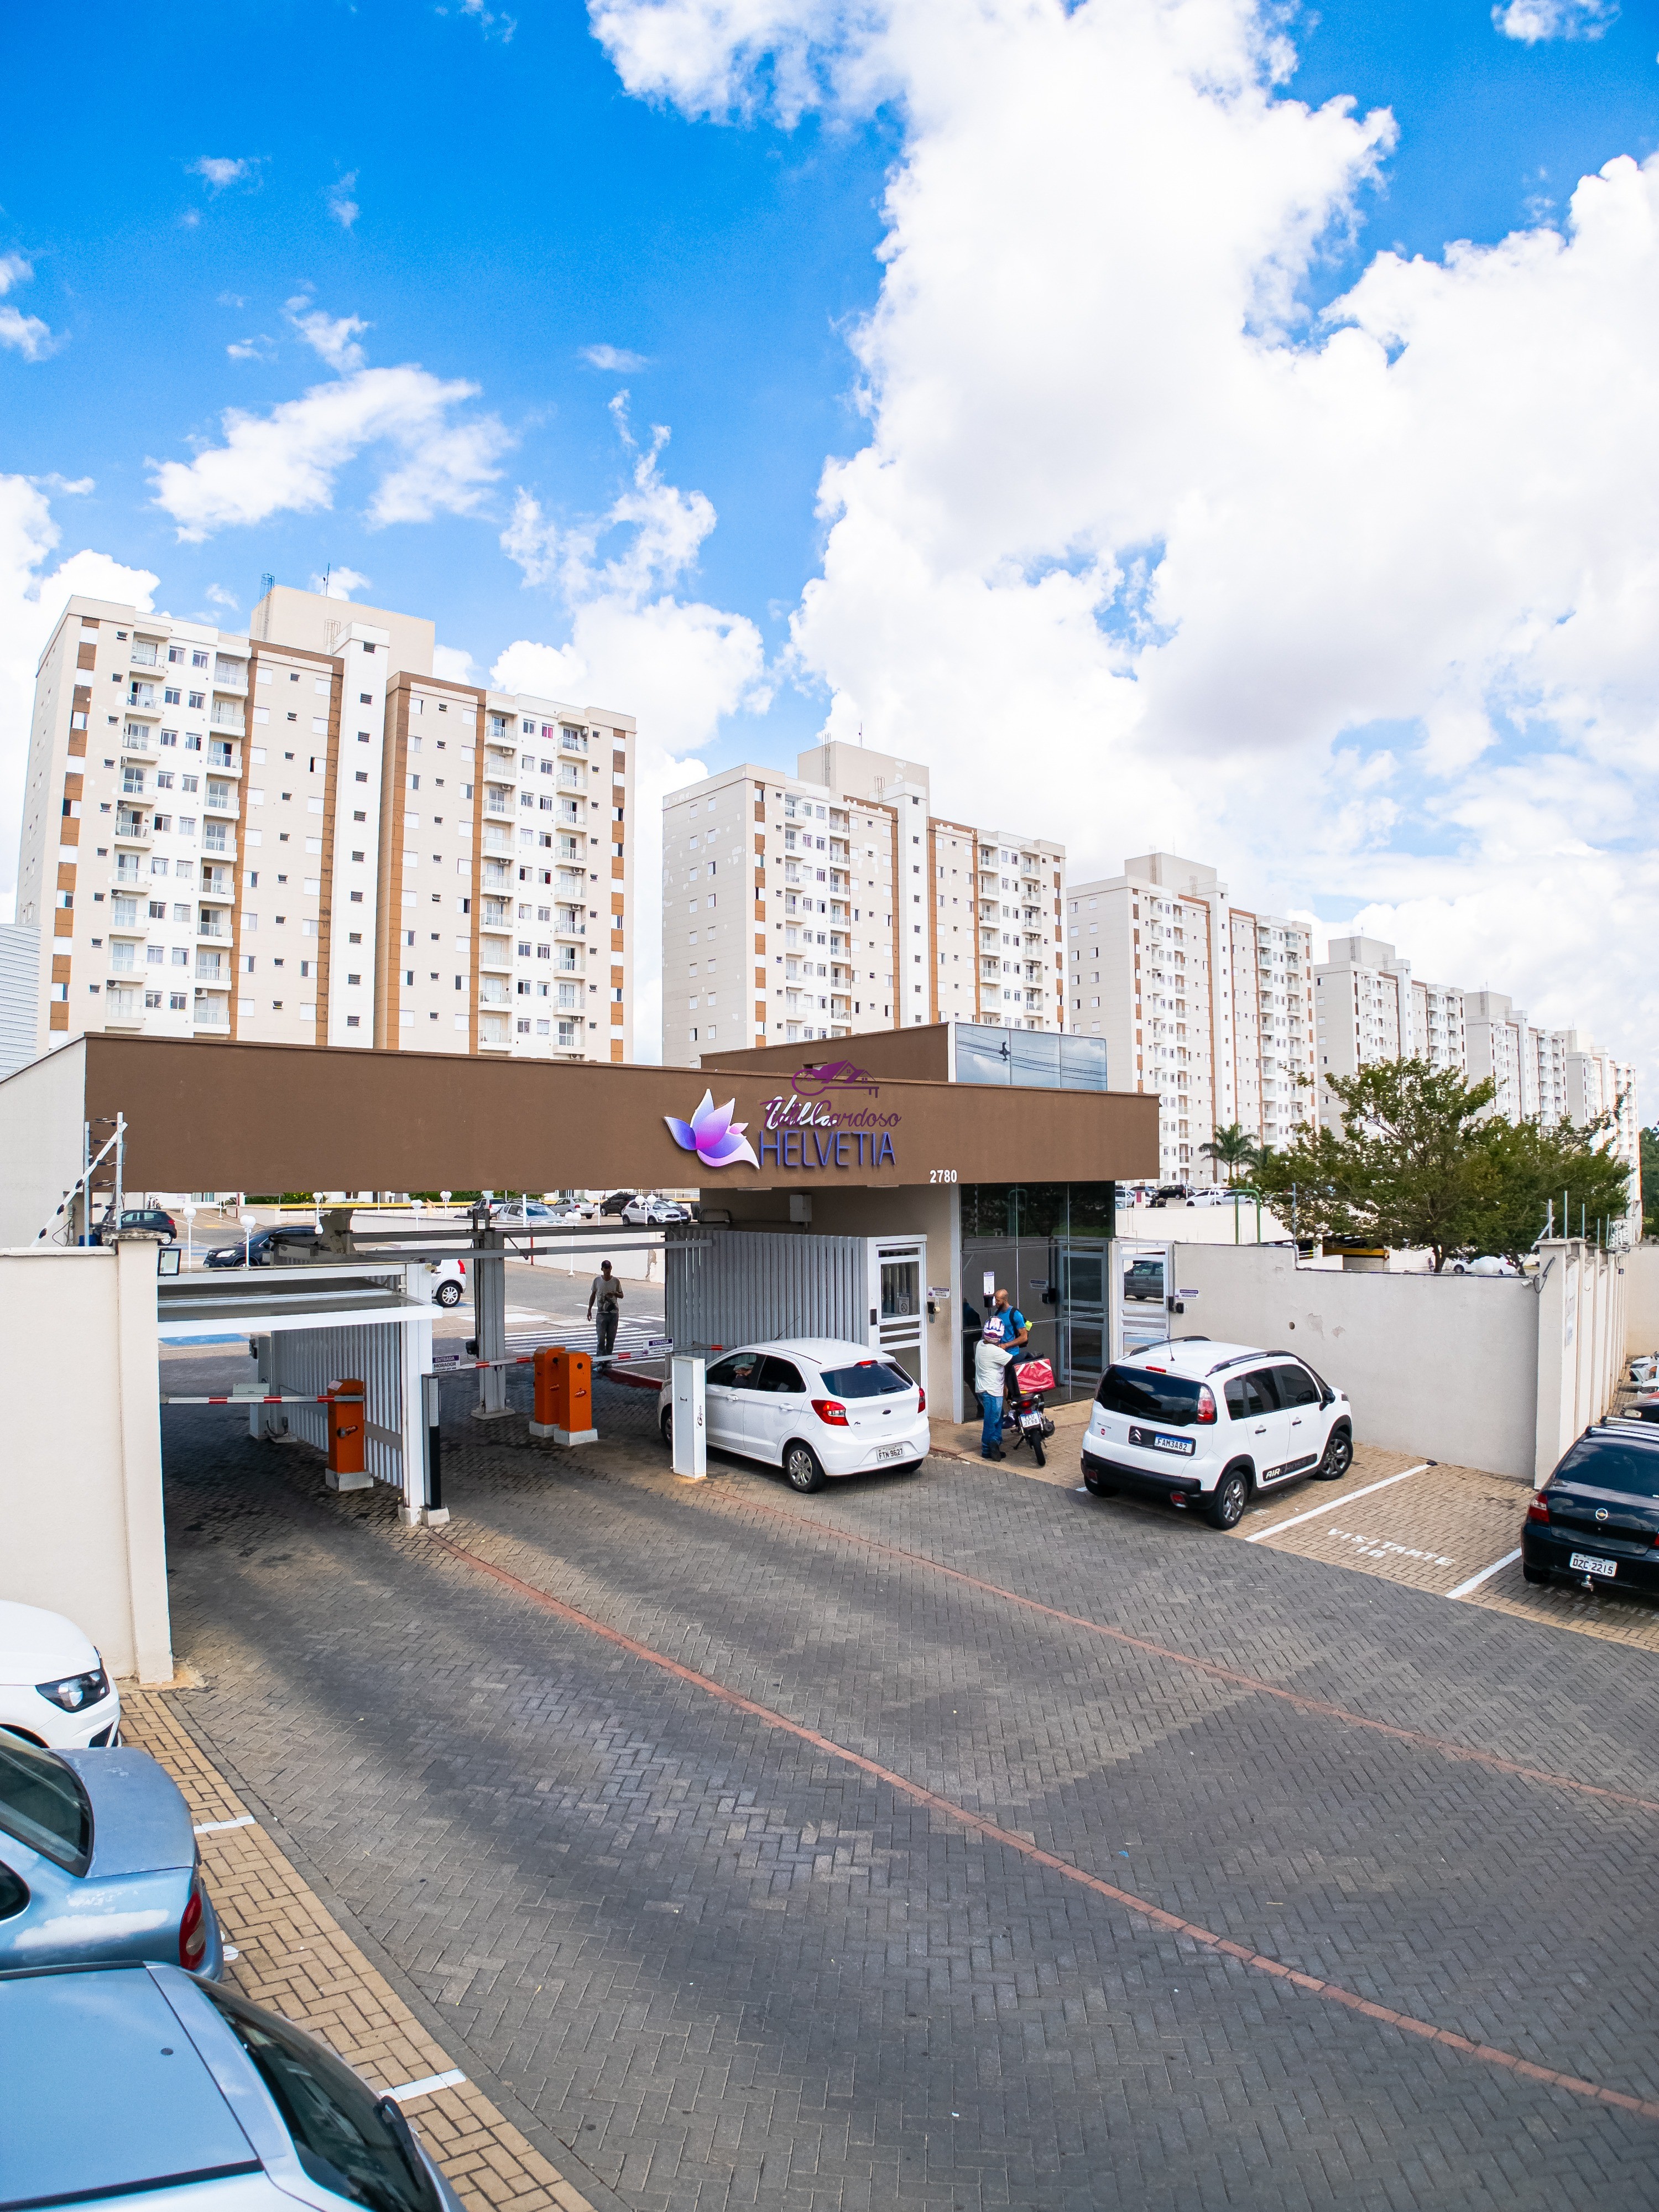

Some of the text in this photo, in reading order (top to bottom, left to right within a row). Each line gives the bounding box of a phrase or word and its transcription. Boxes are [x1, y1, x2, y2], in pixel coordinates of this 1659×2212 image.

[759, 1130, 896, 1166] HELVETIA
[930, 1169, 957, 1183] 2780
[1157, 1438, 1187, 1451] FAM3A82
[1327, 1528, 1457, 1566] VISITANTE
